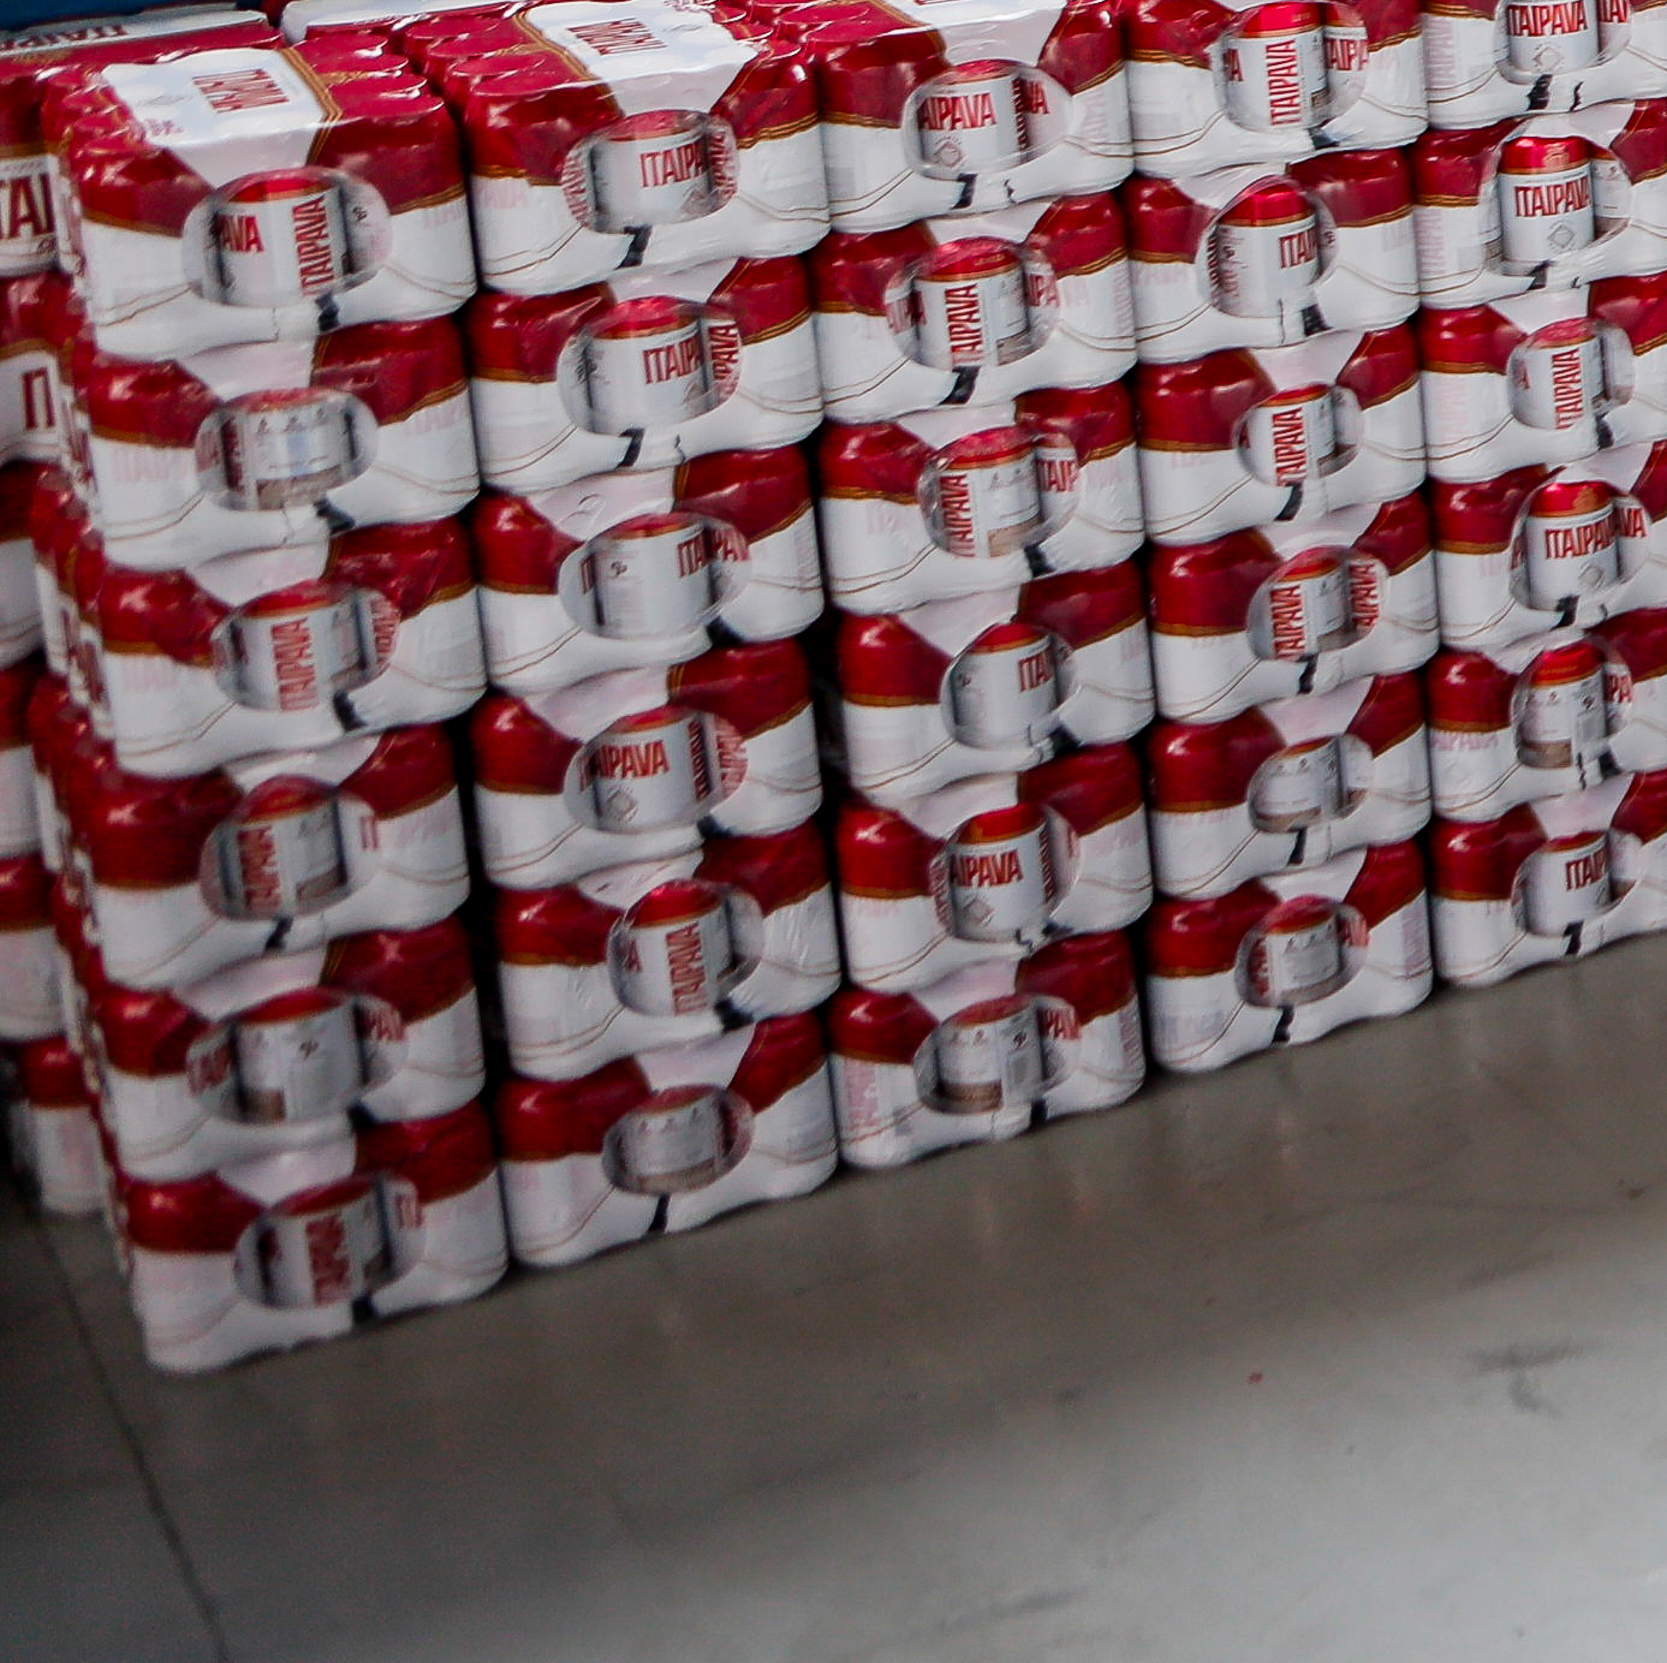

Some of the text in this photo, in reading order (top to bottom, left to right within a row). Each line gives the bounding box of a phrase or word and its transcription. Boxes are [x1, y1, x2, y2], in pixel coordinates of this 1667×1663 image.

[1264, 38, 1300, 126] ITAIPAVA
[944, 283, 984, 366] ITAIPAVA
[1551, 347, 1583, 431] ITAIPAVA
[1271, 406, 1308, 487] ITAIPAVA
[1269, 584, 1306, 661] ITAIPAVA
